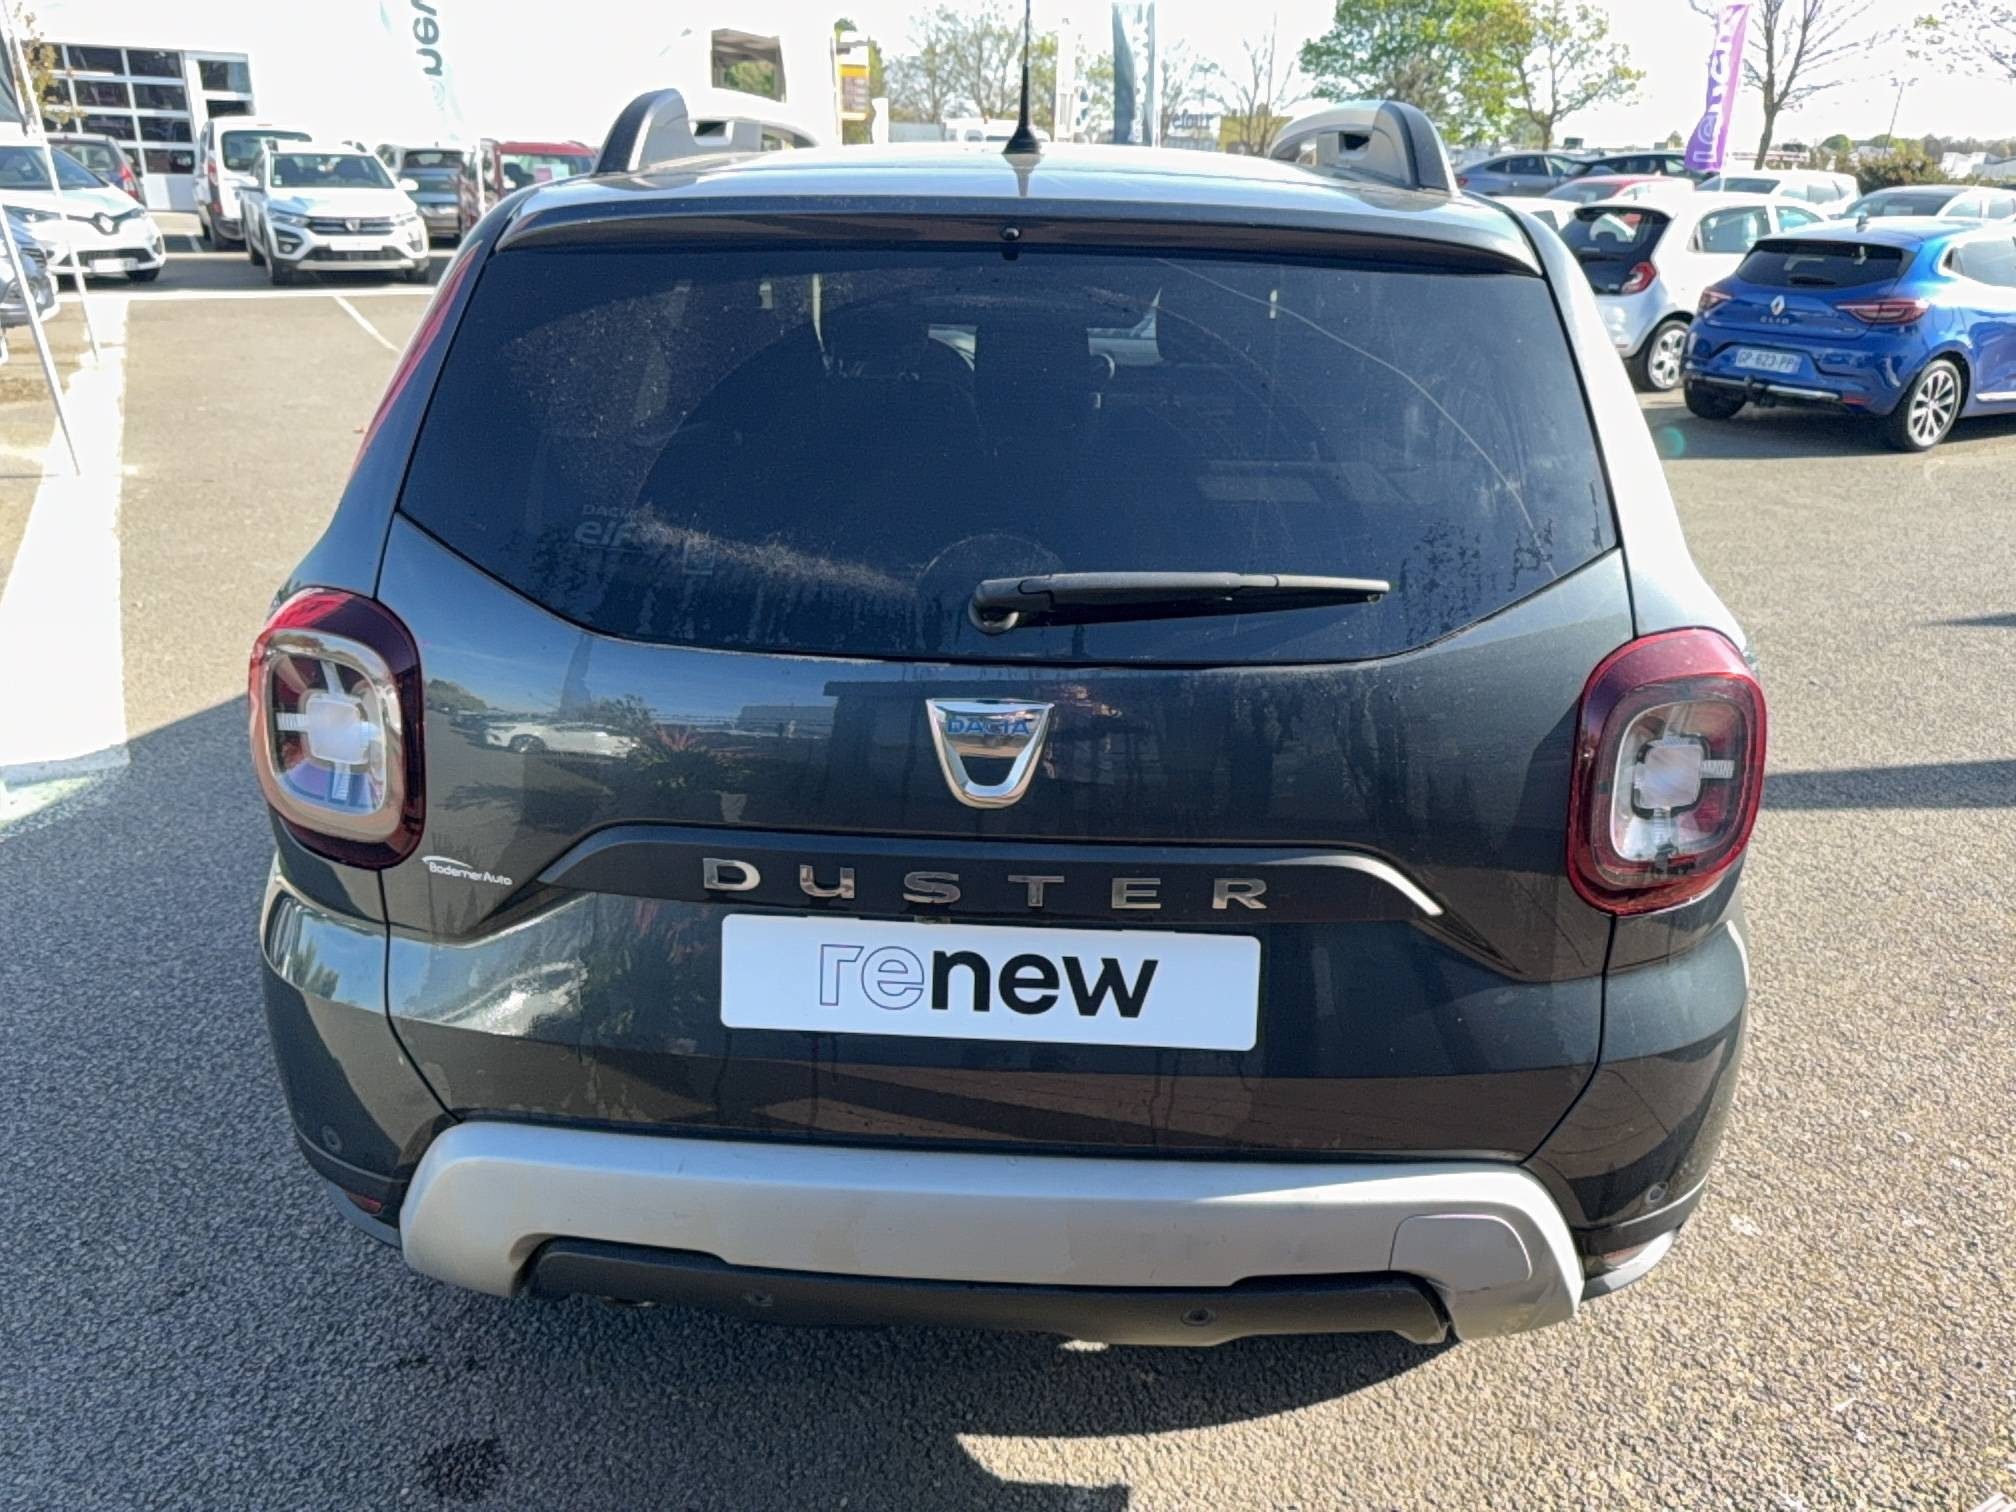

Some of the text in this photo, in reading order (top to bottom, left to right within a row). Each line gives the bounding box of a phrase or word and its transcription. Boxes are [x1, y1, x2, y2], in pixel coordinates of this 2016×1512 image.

[947, 718, 1030, 735] DACIA
[703, 858, 1267, 909] DUSTER
[819, 944, 1158, 1018] renew
